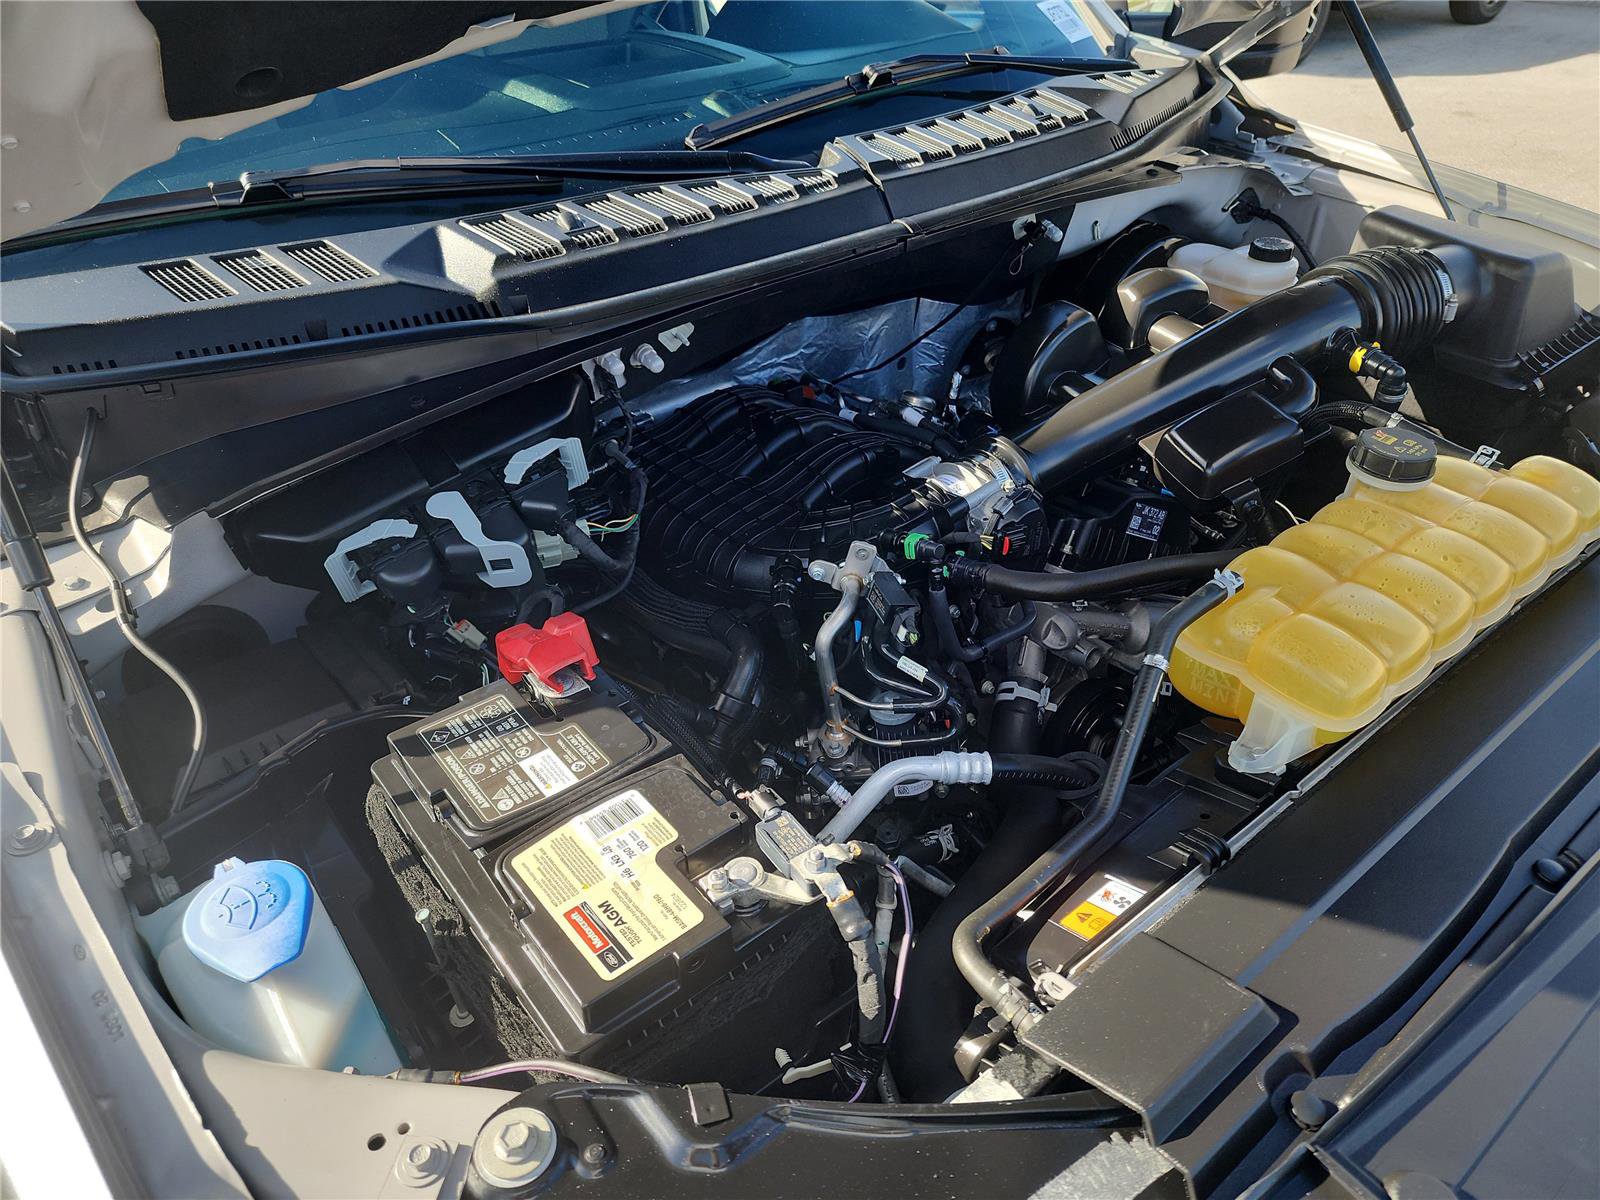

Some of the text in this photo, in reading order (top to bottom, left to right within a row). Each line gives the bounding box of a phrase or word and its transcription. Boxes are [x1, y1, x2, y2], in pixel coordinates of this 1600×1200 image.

[1190, 678, 1228, 702] MIN
[622, 845, 637, 859] 760
[636, 839, 649, 851] 120
[610, 853, 625, 867] LN3
[621, 866, 635, 879] H6
[597, 899, 627, 929] AGM
[569, 910, 604, 949] Motorcraft
[619, 927, 637, 947] TESTED
